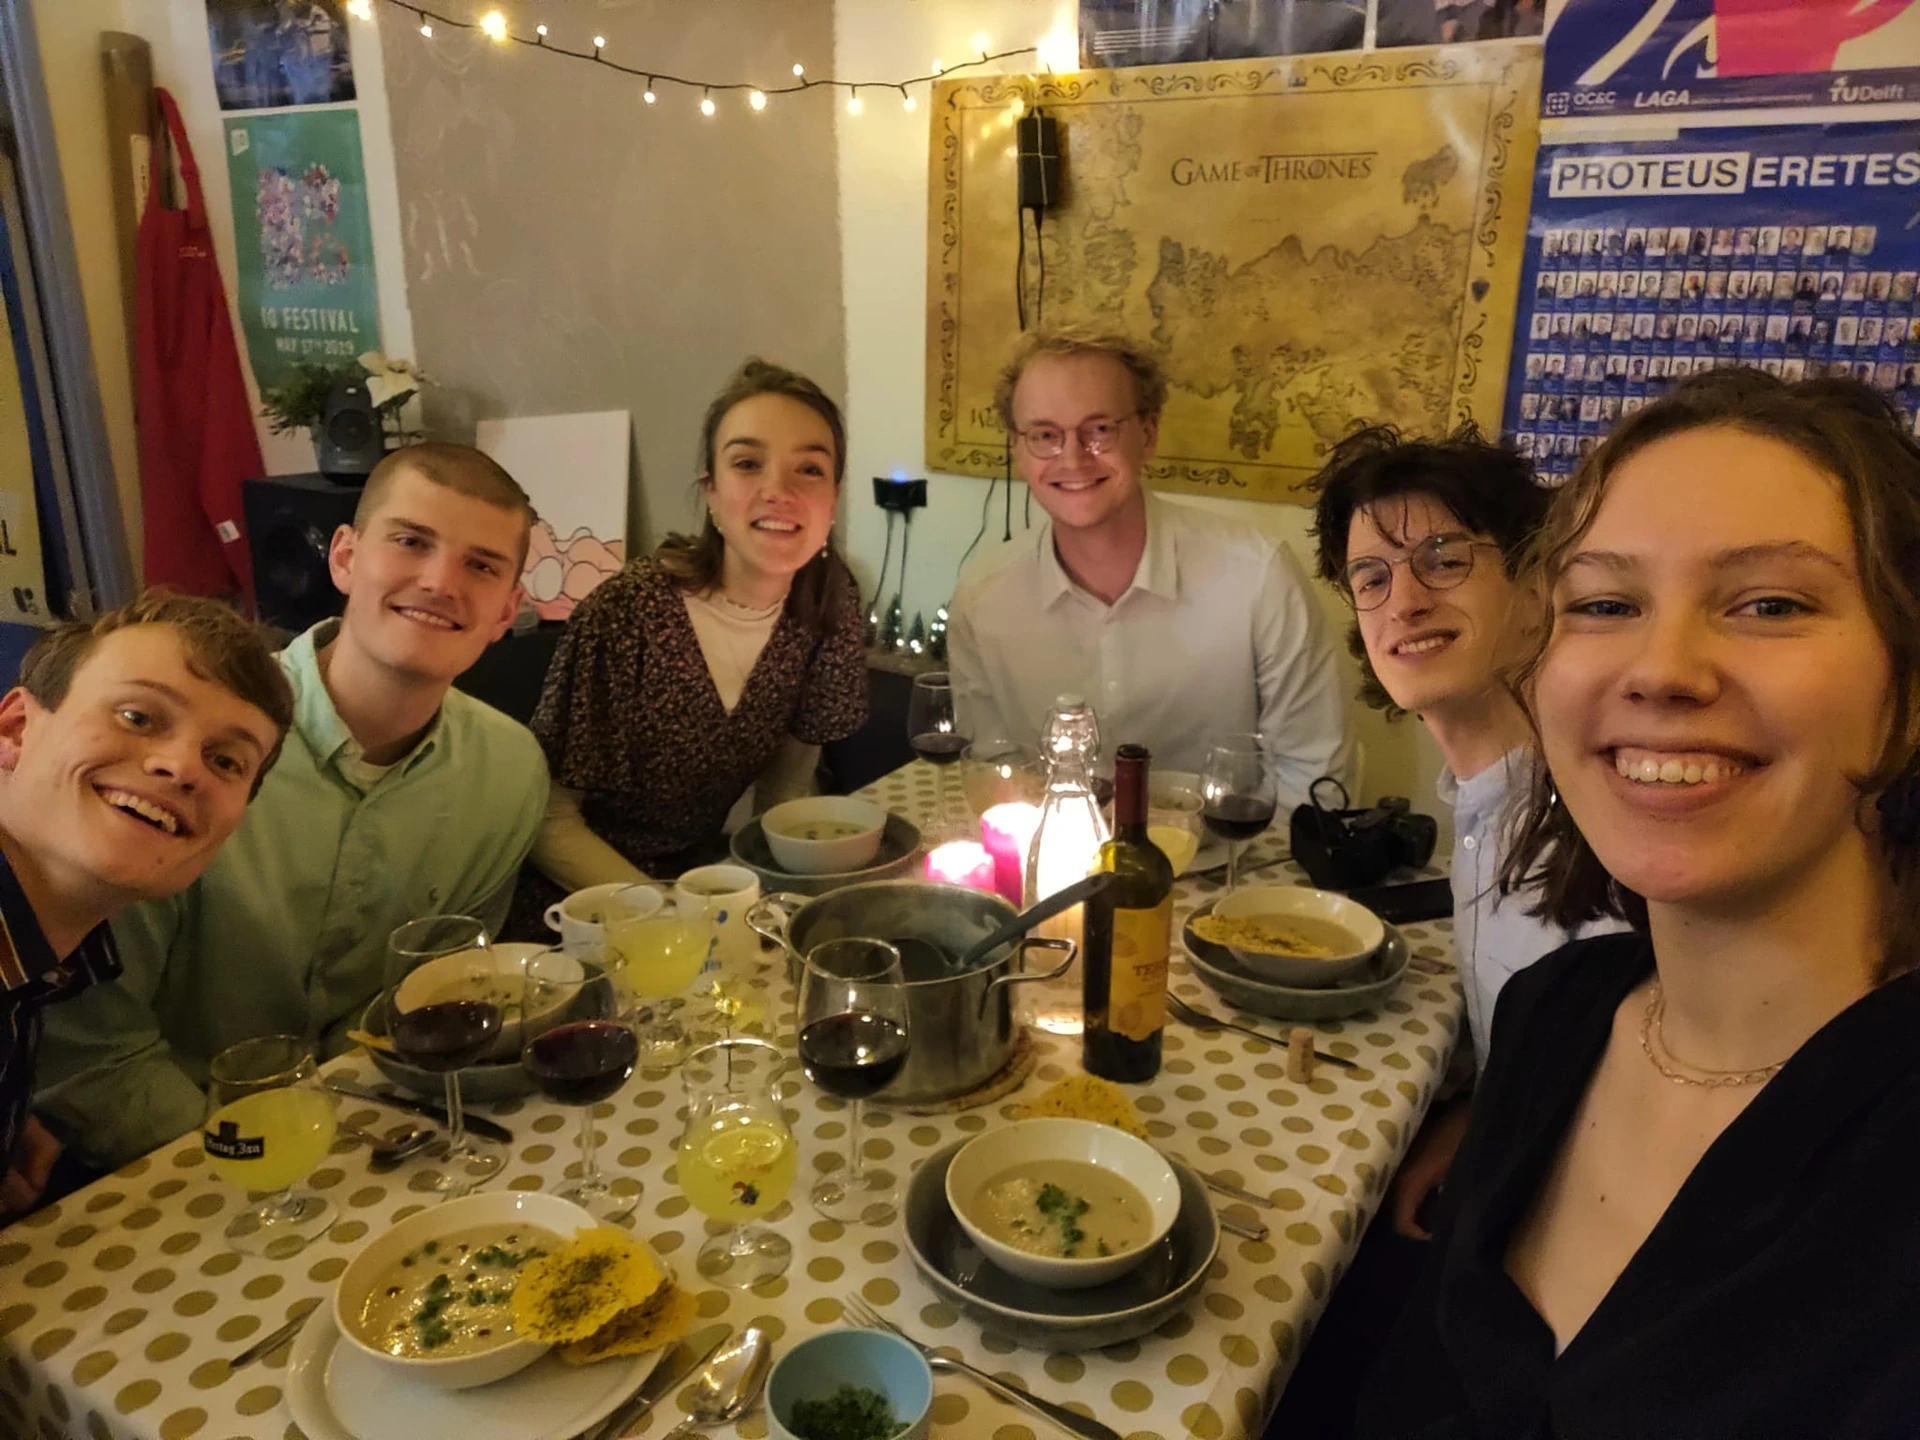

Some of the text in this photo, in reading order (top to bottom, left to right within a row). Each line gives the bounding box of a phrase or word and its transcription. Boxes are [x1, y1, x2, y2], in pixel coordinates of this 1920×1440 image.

[1634, 90, 1690, 107] LAGA
[1171, 157, 1241, 187] GAME
[1259, 152, 1378, 184] THRONES
[1556, 152, 1920, 190] PROTEUS ERETES
[282, 307, 359, 333] FESTIVAL
